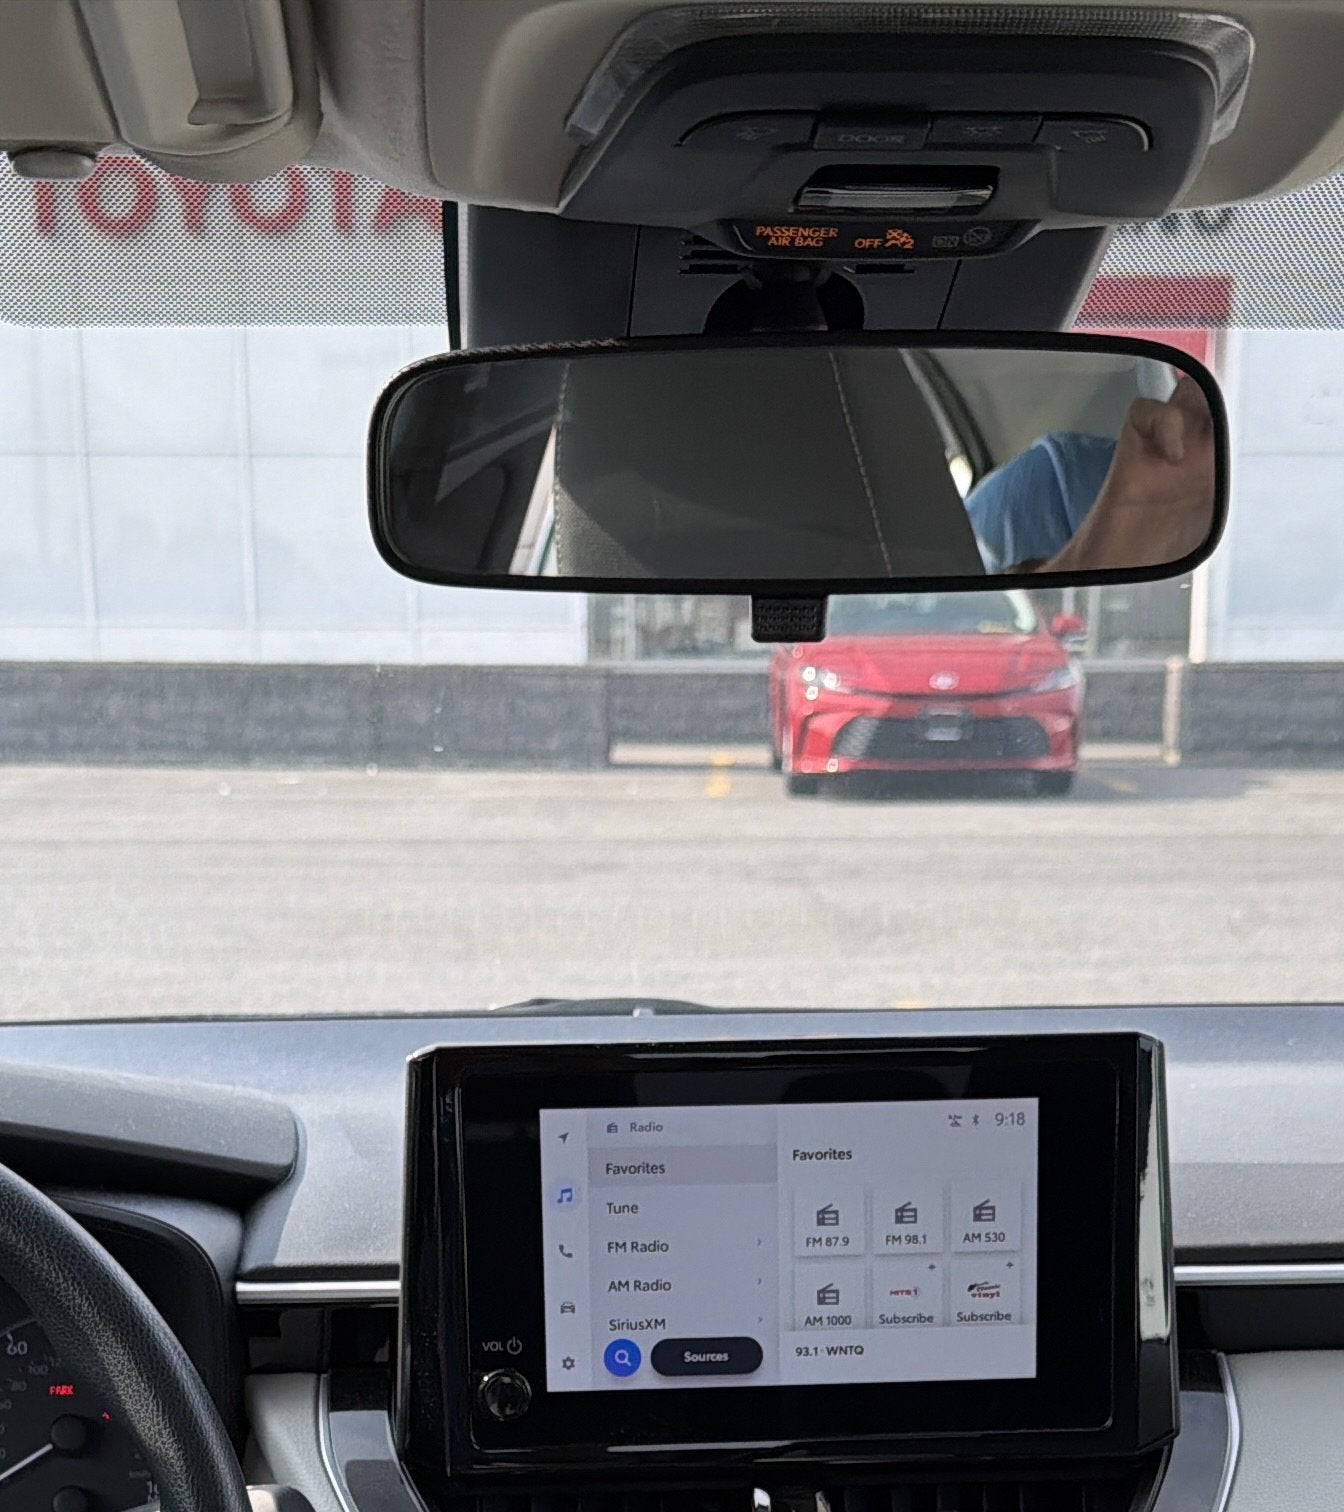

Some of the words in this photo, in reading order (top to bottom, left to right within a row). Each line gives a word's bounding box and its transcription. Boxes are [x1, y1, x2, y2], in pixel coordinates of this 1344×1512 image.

[756, 226, 838, 239] PASSENGER
[768, 236, 791, 247] AIR
[794, 237, 824, 247] BAG
[855, 239, 883, 249] OFF
[995, 1112, 1026, 1126] 9:18
[630, 1122, 663, 1133] Radio
[792, 1148, 852, 1161] Favorites
[606, 1162, 666, 1175] Favorites
[607, 1202, 639, 1214] Tune
[806, 1237, 822, 1247] FM
[825, 1236, 850, 1247] 87.9
[885, 1234, 903, 1245] FM
[904, 1234, 927, 1245] 98.1
[963, 1232, 982, 1243] AM
[984, 1231, 1006, 1242] 530
[607, 1242, 627, 1253] FM
[631, 1240, 669, 1253] Radio
[608, 1281, 630, 1292] AM
[633, 1279, 672, 1292] Radio
[804, 1316, 823, 1326] AM
[826, 1315, 852, 1326] 1000
[879, 1314, 934, 1325] Subscribe
[957, 1311, 1012, 1322] Subscribe
[609, 1319, 666, 1331] SiriusXM
[7, 1341, 28, 1355] 60
[482, 1341, 504, 1351] VOL
[795, 1346, 818, 1357] 93.1
[826, 1345, 864, 1357] WNTQ
[684, 1351, 729, 1363] Sources
[49, 1385, 75, 1396] PARK
